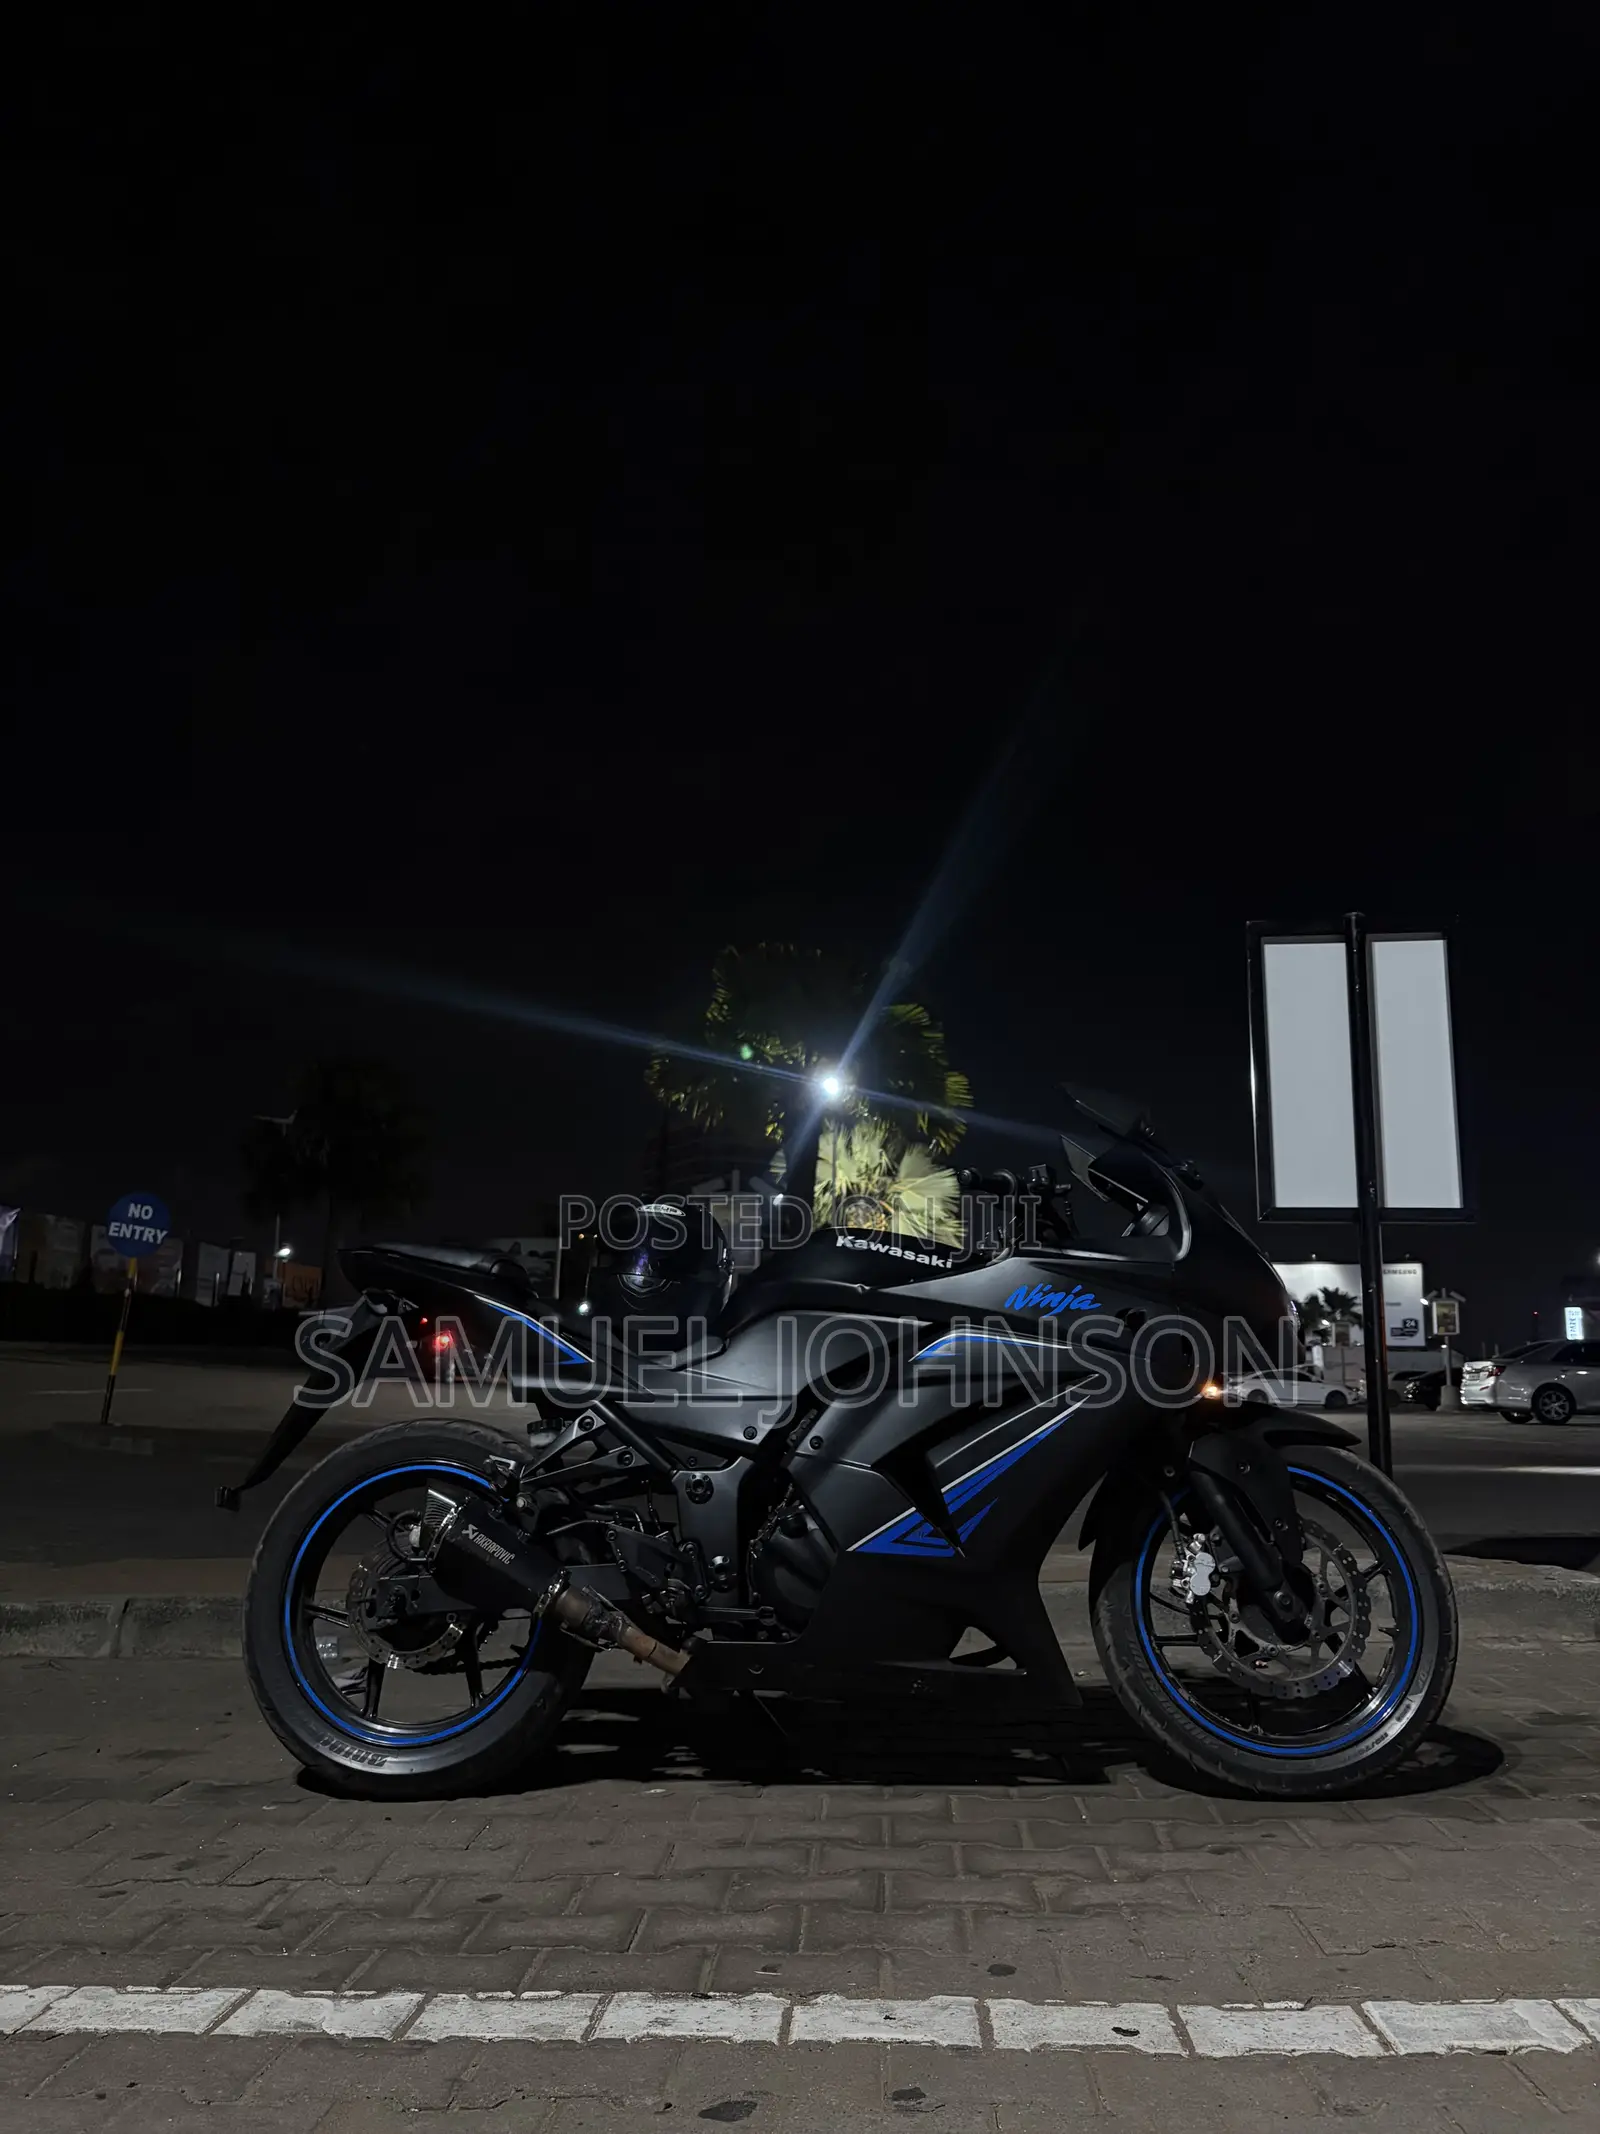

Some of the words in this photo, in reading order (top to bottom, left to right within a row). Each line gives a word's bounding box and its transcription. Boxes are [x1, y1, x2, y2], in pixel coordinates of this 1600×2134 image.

[128, 1203, 153, 1220] NO
[108, 1222, 168, 1244] ENTRY
[836, 1235, 952, 1268] Kawasaki
[1004, 1283, 1102, 1318] Ninja
